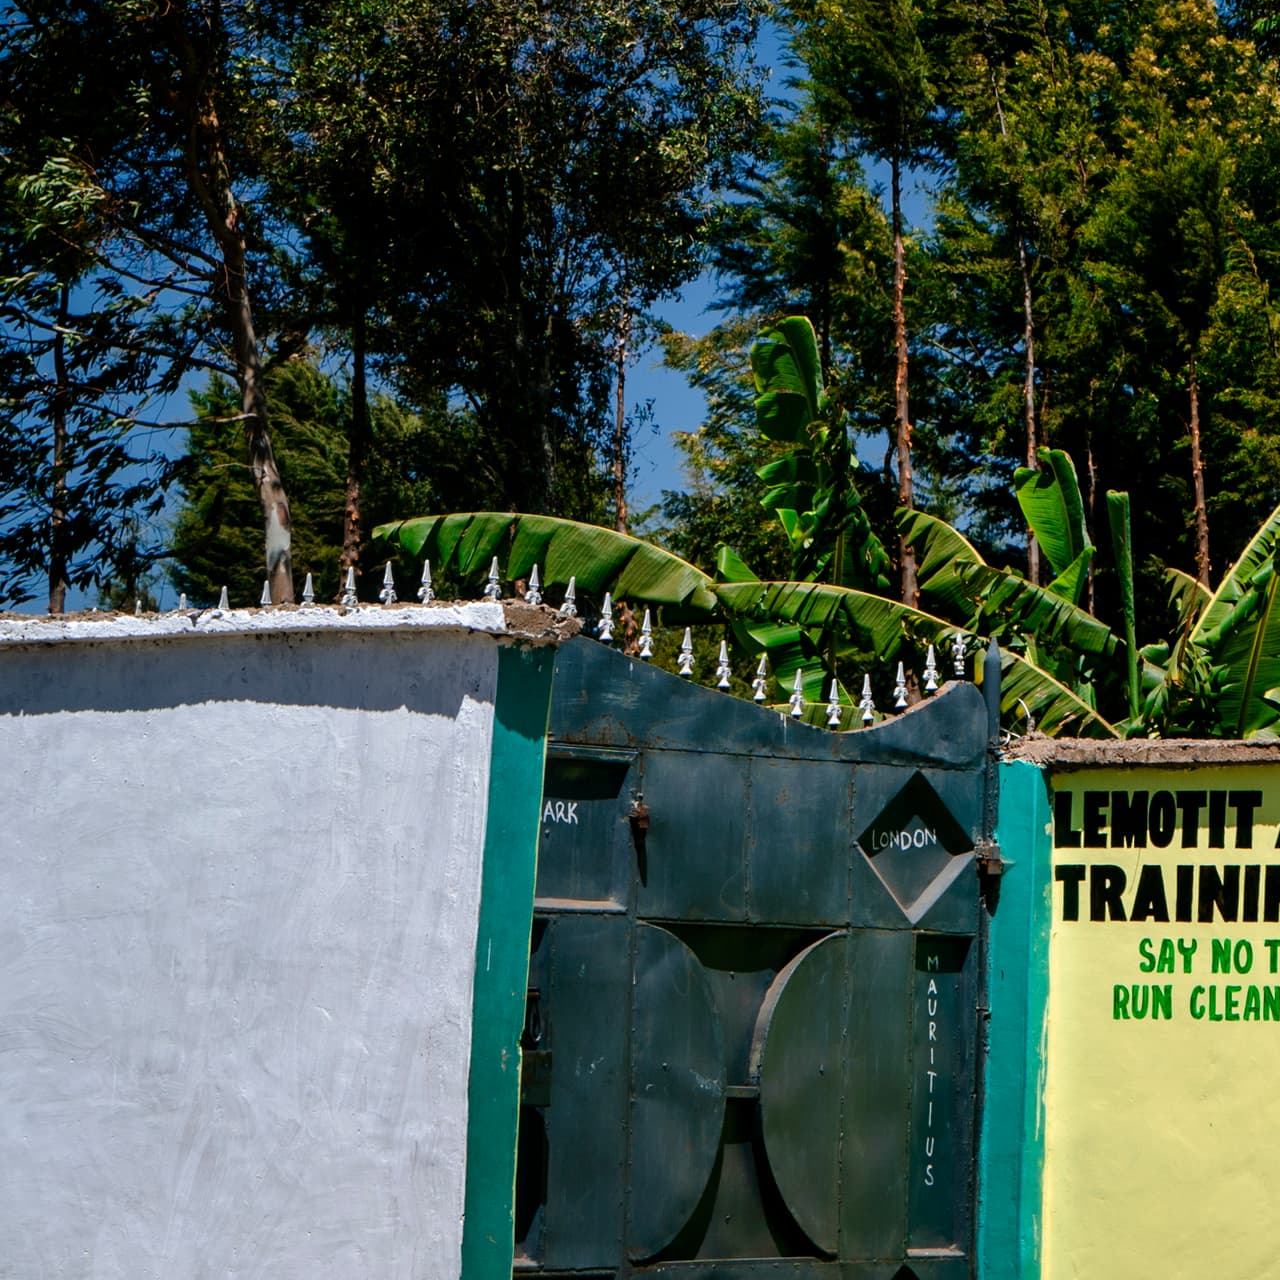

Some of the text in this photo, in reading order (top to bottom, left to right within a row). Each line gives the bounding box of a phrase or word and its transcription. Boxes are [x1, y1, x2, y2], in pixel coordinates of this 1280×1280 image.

[540, 800, 578, 824] ARK
[1054, 790, 1263, 849] LEMOTIT
[872, 828, 937, 851] LONDON
[1139, 938, 1197, 974] SAY
[1211, 938, 1254, 975] NO
[1112, 984, 1173, 1021] RUN
[924, 954, 938, 1186] MAURITIUS
